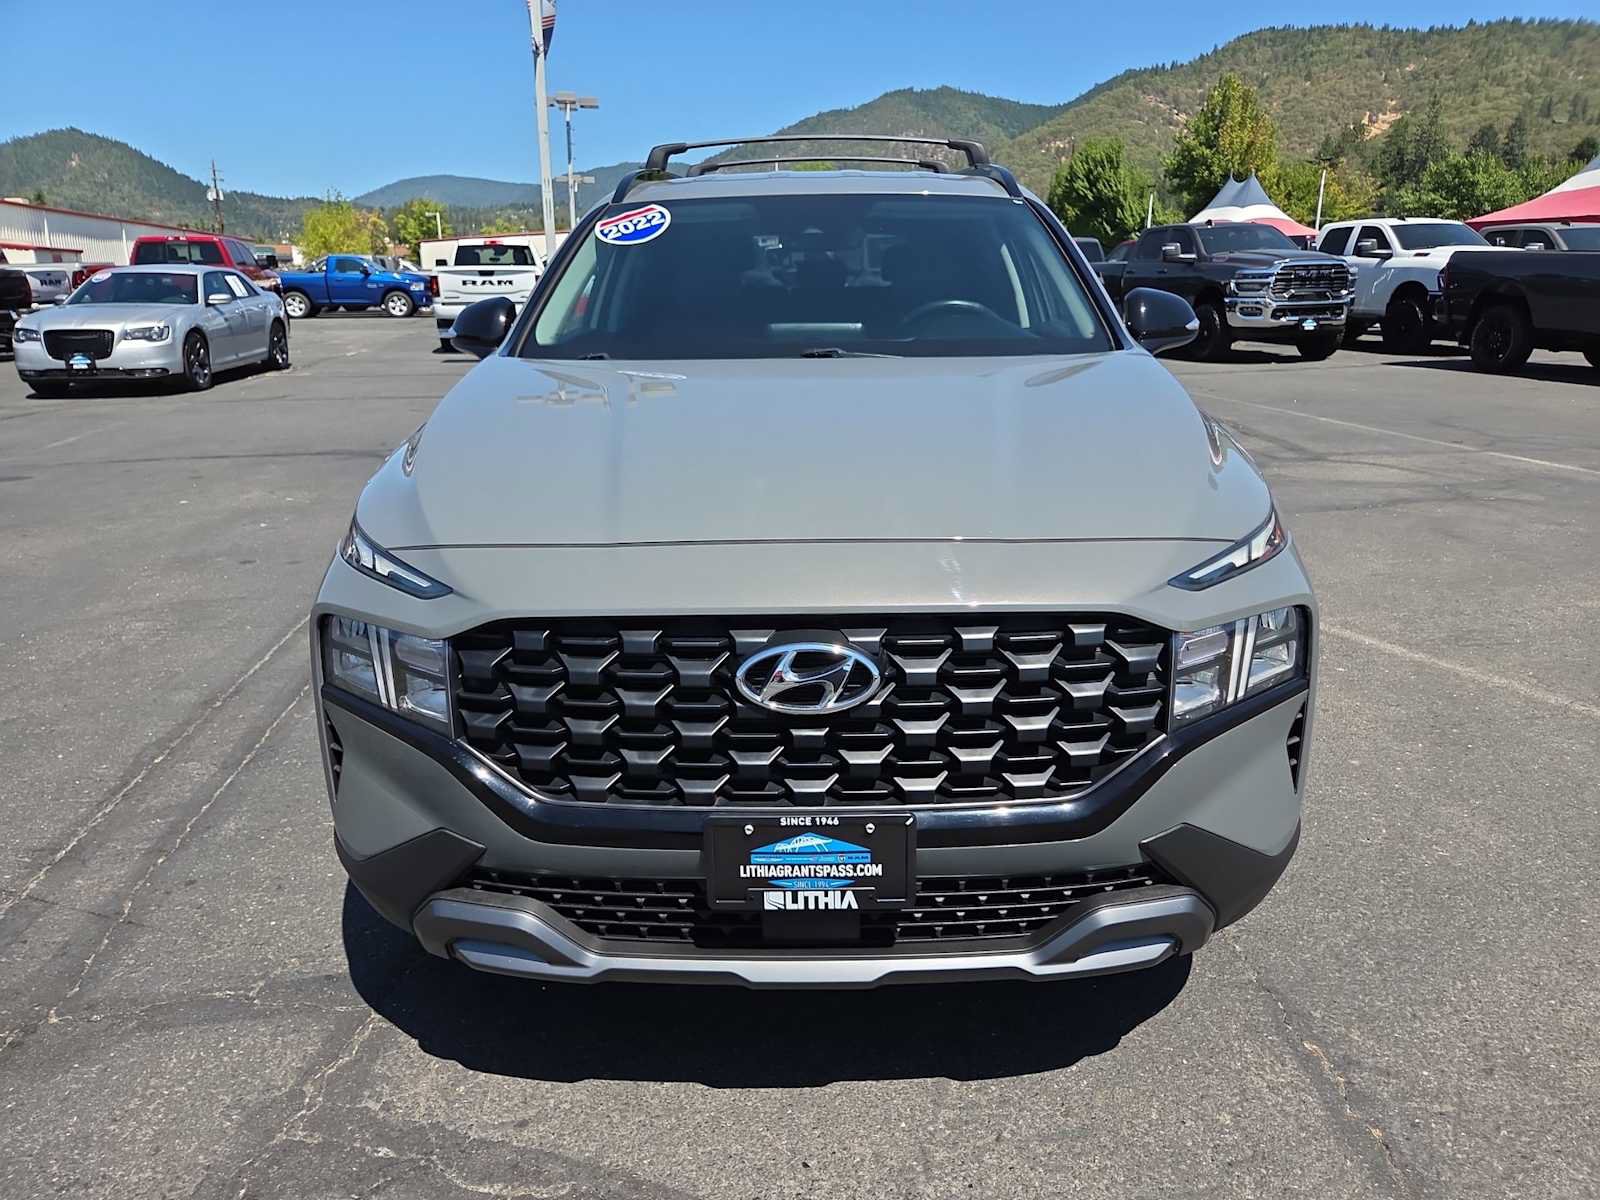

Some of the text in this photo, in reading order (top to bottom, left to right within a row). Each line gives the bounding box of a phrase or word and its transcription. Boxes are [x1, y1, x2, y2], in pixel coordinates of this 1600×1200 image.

[603, 211, 665, 240] 2022
[461, 279, 514, 287] RAM
[780, 817, 839, 826] SINCE 1946
[739, 863, 883, 878] LITHIAGRANTSPASS.COM
[786, 890, 858, 910] LITHIA
